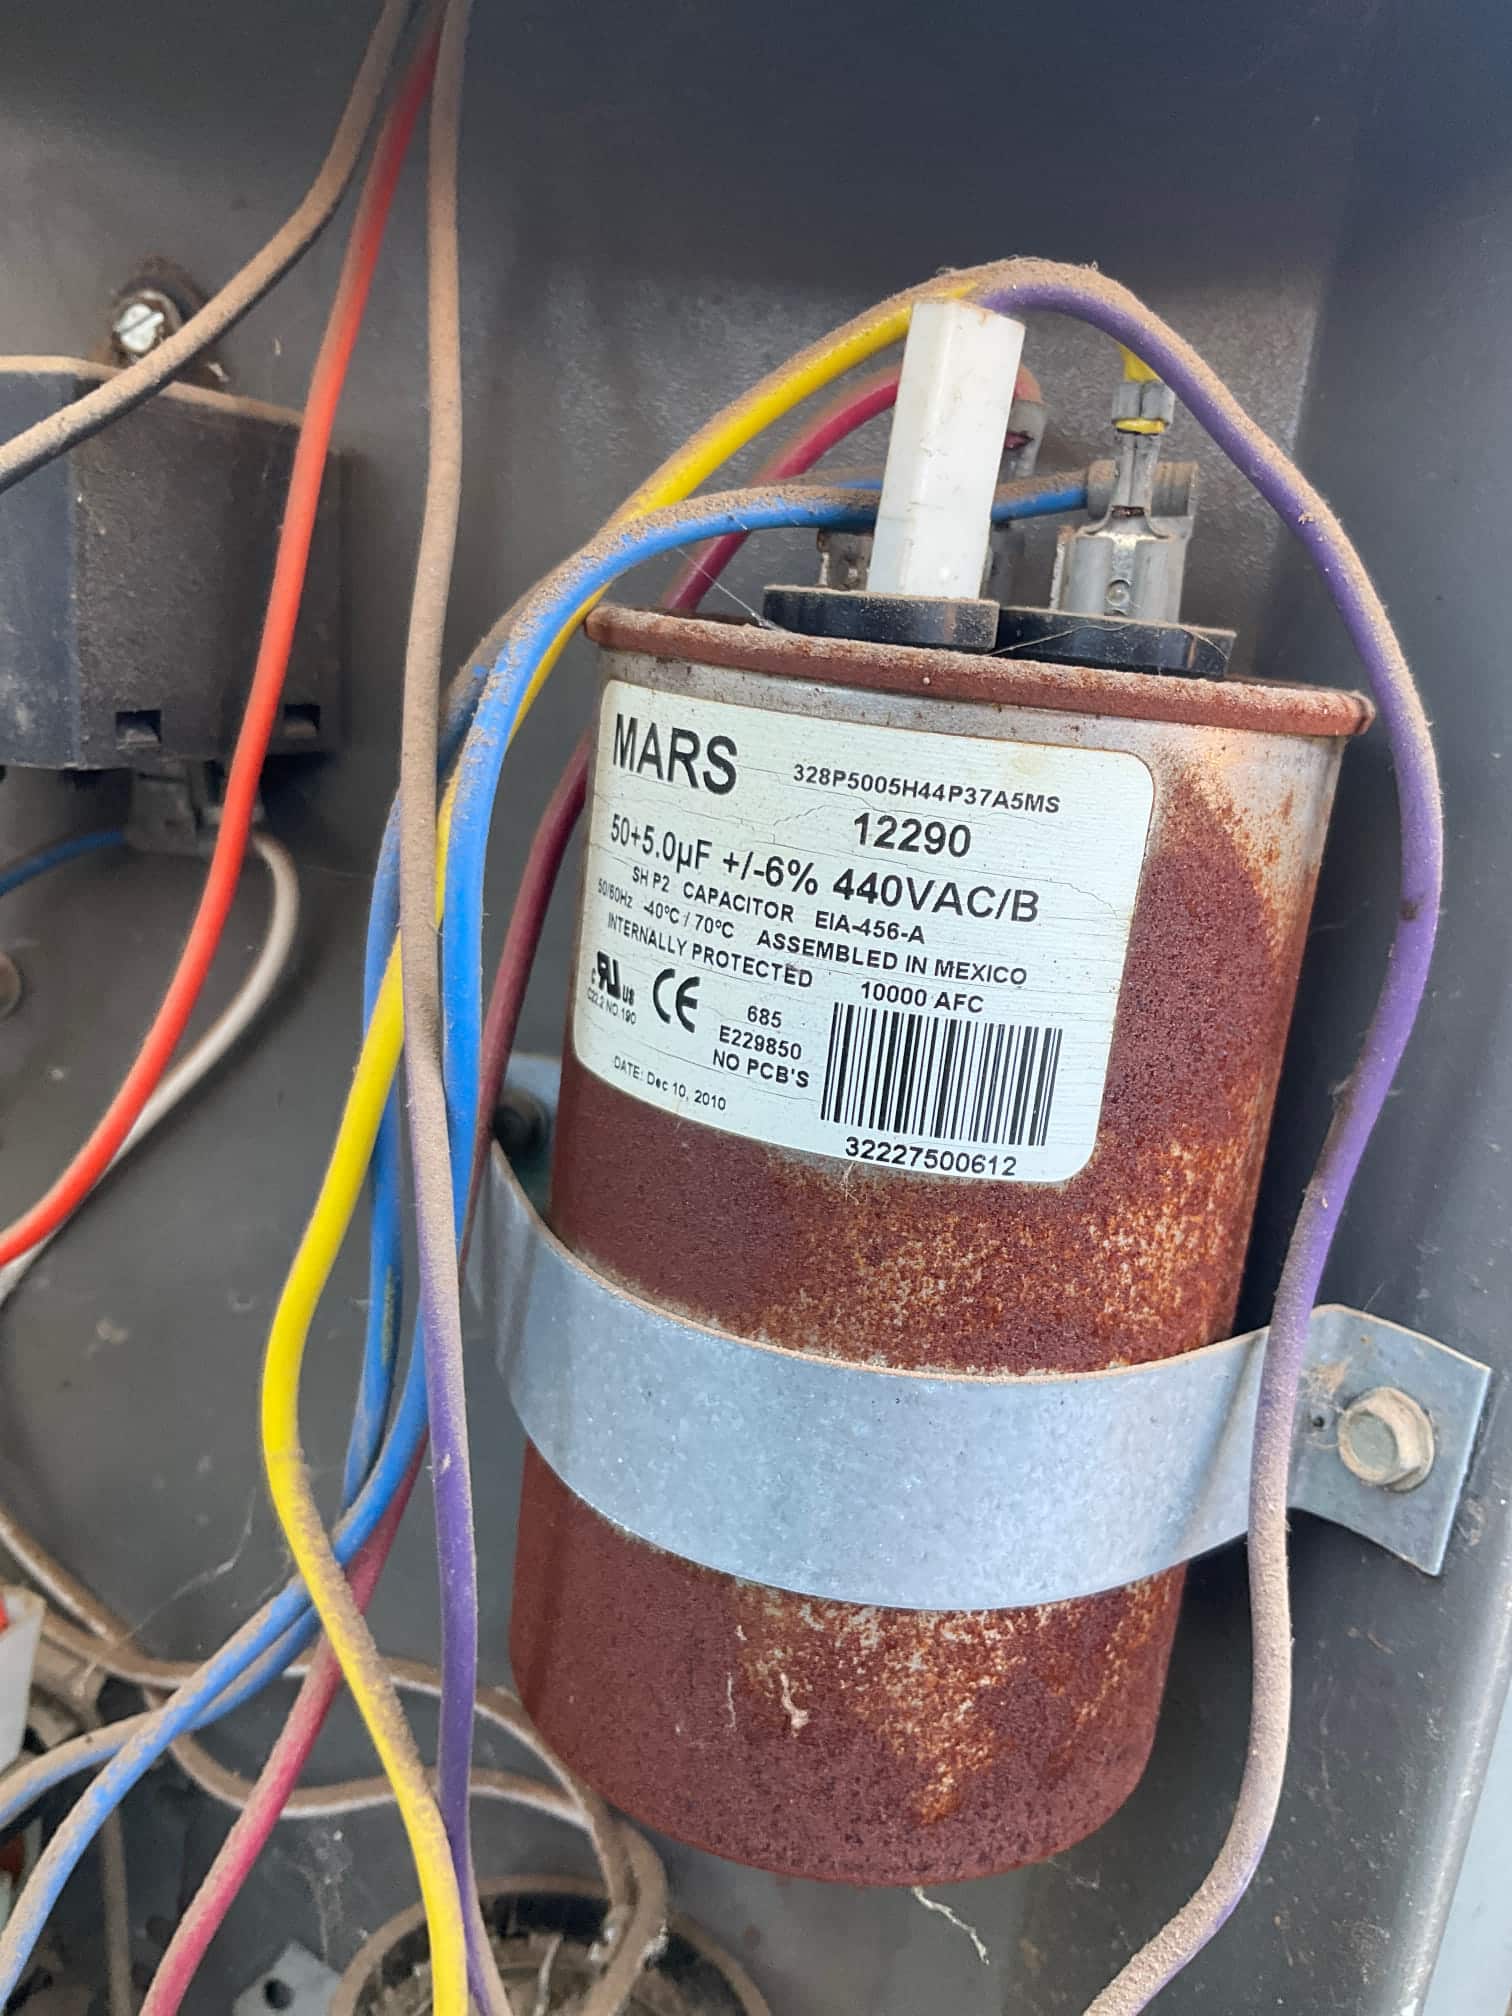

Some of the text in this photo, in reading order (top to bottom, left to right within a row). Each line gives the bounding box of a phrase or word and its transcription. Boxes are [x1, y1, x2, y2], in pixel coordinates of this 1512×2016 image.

[613, 713, 738, 795] MARS
[793, 764, 1061, 813] 328P5005H44P37A5MS
[854, 812, 971, 857] 12290
[632, 866, 925, 944] SH P2 CAPACITOR EIA-456-A
[723, 852, 818, 896] +/-6%
[833, 868, 1039, 922] 440VAC/B
[608, 912, 813, 987] INTERNALLY PROTECTED
[757, 930, 898, 970] ASSEMBLED
[905, 955, 927, 975] IN
[934, 959, 1027, 985] MEXICO
[653, 968, 700, 1033] CE
[748, 1006, 782, 1028] 685
[861, 982, 984, 1013] 10000 AFC
[720, 1025, 802, 1060] E229850
[614, 1056, 726, 1110] DATE: Dec 10, 2010
[713, 1049, 810, 1088] NO PCB'S
[845, 1136, 1016, 1176] 32227500612
